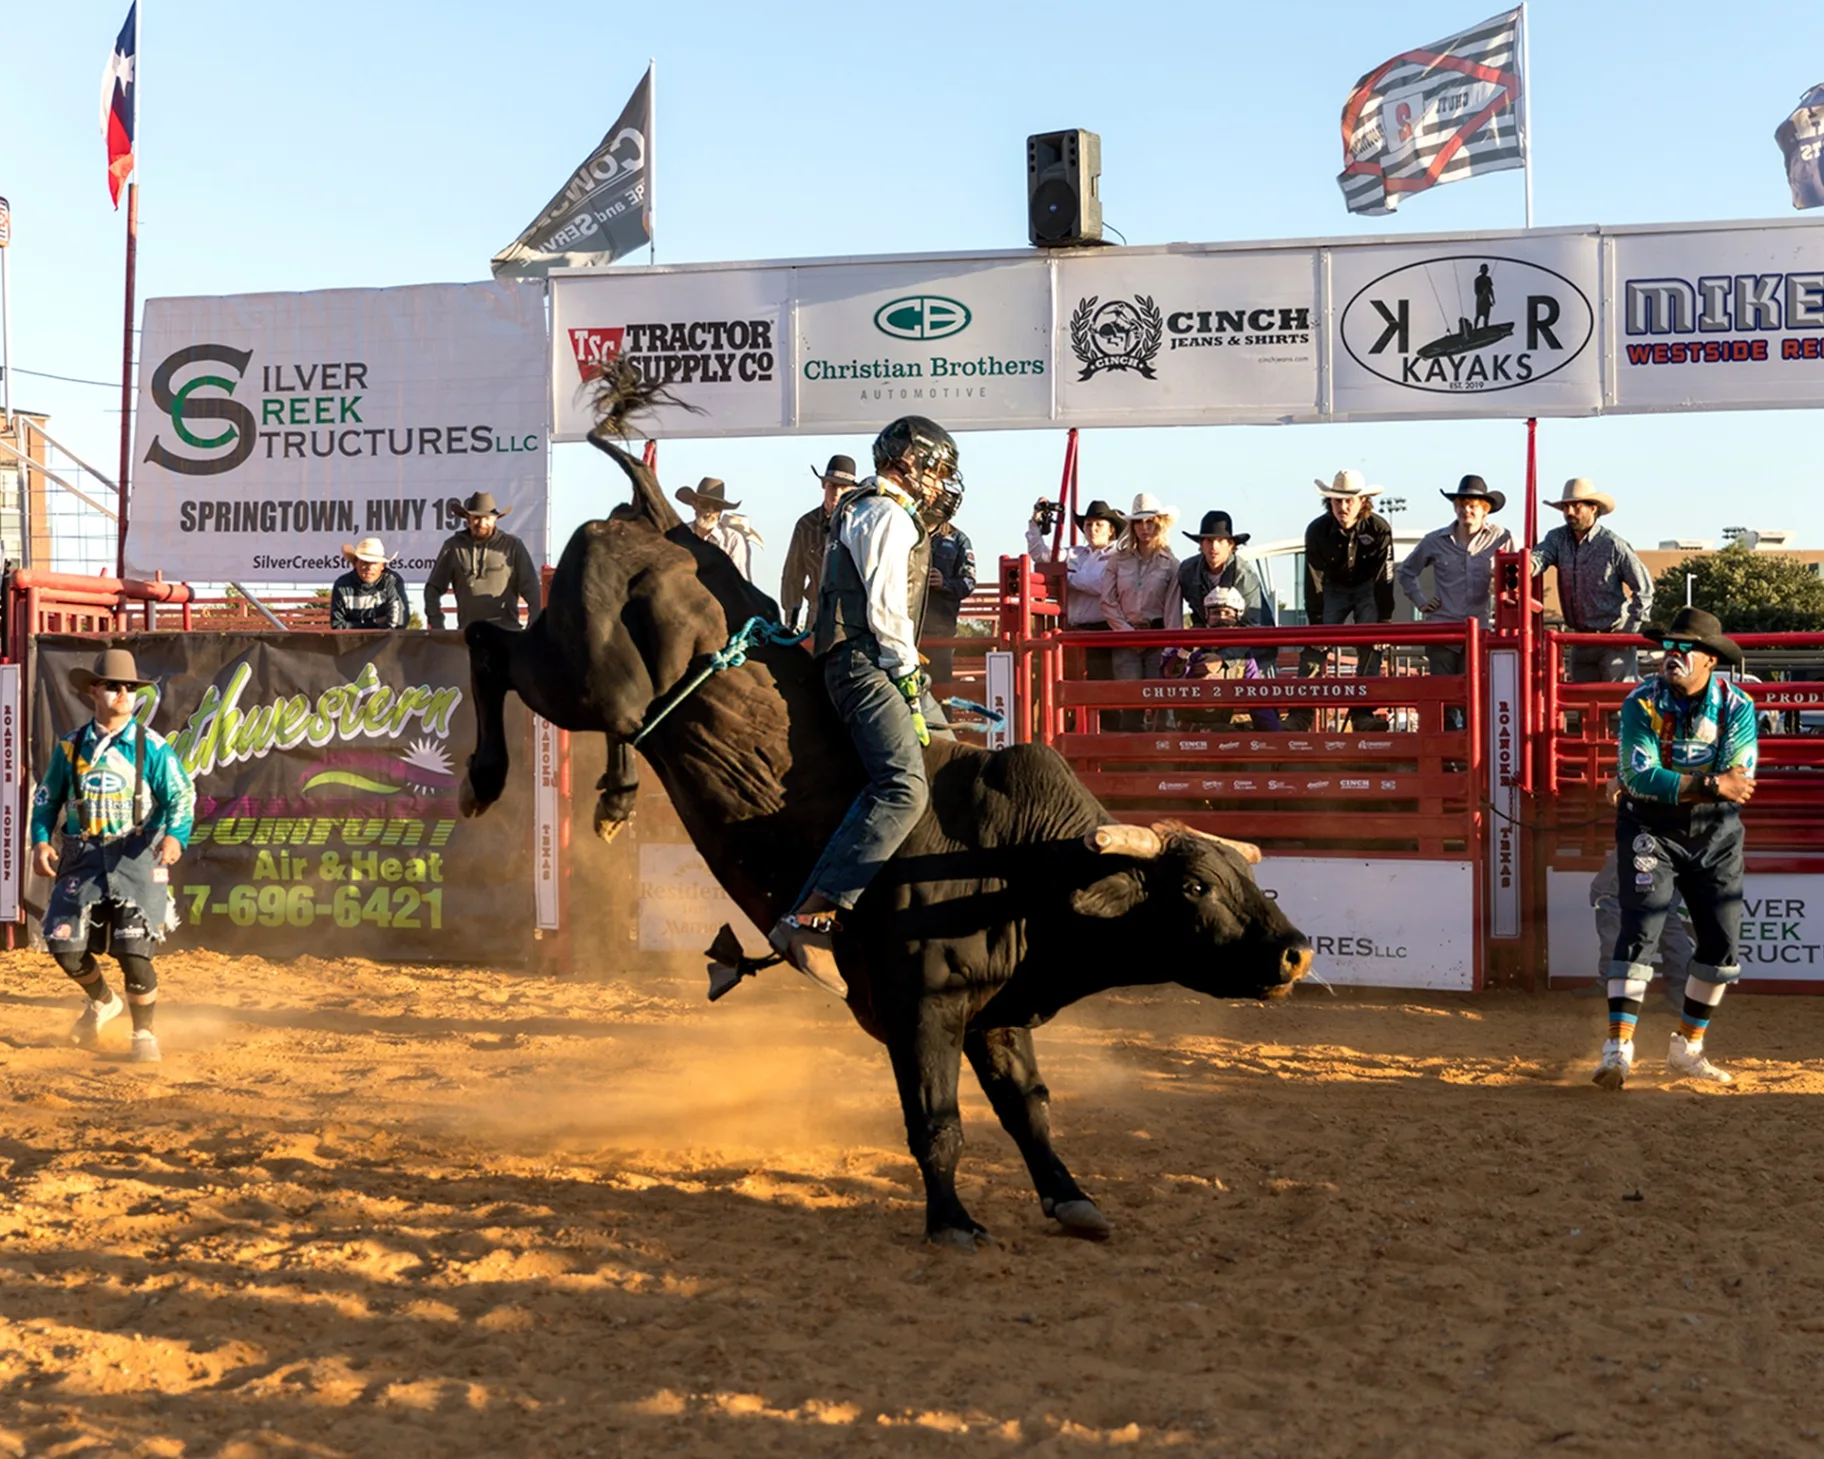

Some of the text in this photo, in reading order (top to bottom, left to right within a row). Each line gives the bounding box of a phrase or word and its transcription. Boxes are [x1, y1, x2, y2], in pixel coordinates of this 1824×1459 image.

[1166, 308, 1310, 334] CINCH
[1526, 295, 1564, 351] R
[626, 320, 772, 353] TRACTOR
[1170, 333, 1309, 350] JEANS & SHIRTS
[1095, 356, 1139, 368] CINCH
[1626, 340, 1768, 365] WESTSIDE
[627, 353, 736, 384] SUPPLY
[804, 356, 1045, 380] Christian Brothers
[1402, 353, 1533, 383] KAYAKS
[860, 387, 987, 400] AUTOMOTIVE
[496, 435, 538, 453] LLC
[180, 501, 360, 534] SPRINGTOWN,
[367, 499, 427, 531] HWY
[1142, 684, 1368, 698] CHUTE 2 PRODUCTIONS
[253, 850, 444, 883] Air & Heat
[1374, 946, 1408, 958] LLC
